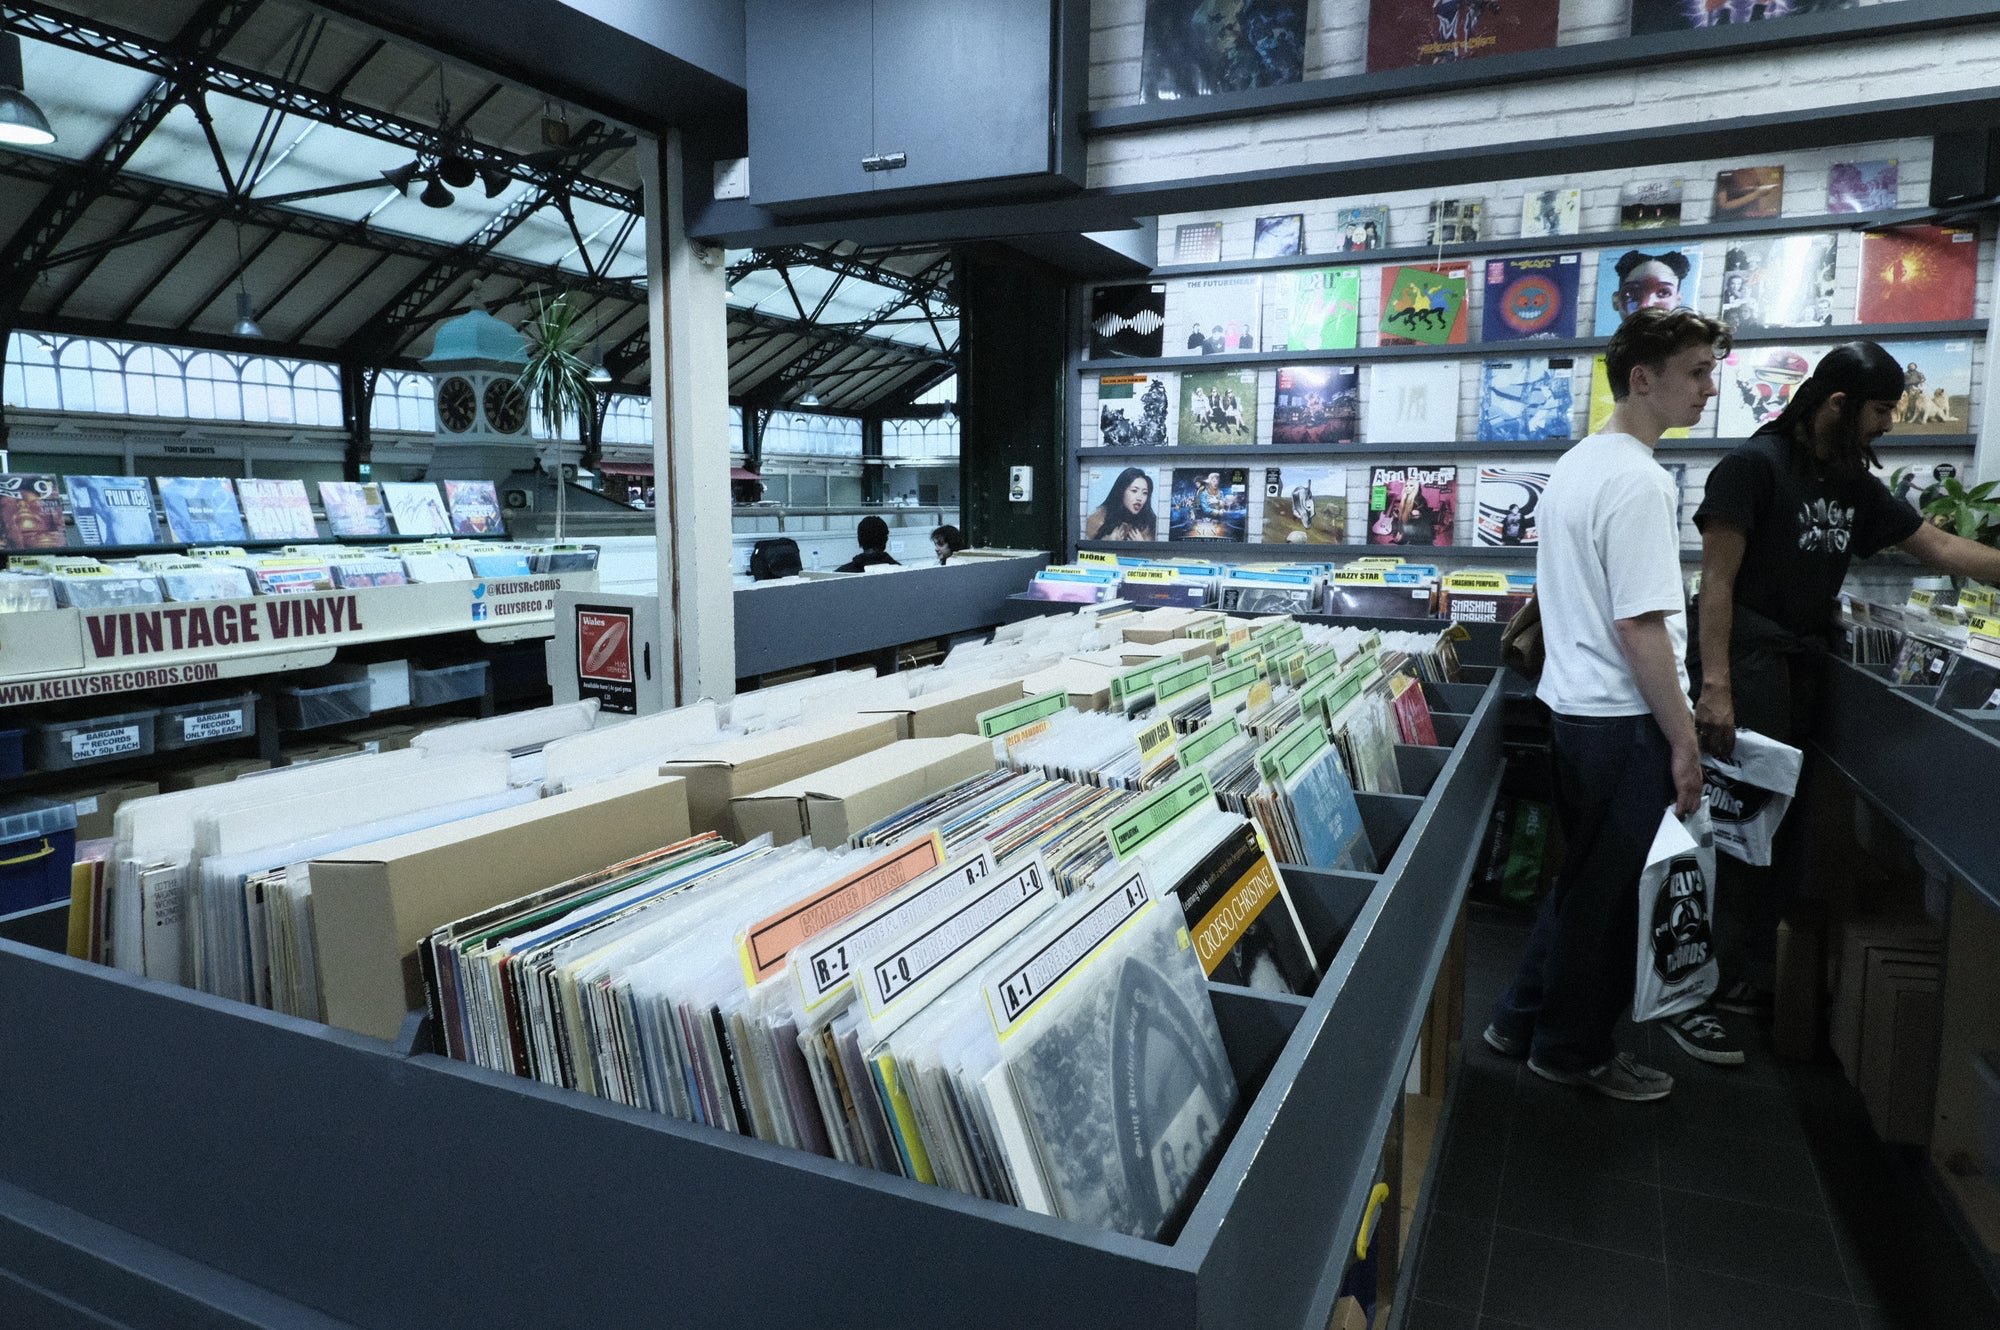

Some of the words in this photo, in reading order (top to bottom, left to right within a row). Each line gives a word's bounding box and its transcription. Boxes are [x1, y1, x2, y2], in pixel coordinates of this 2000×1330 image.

[1187, 281, 1202, 289] THE
[106, 489, 130, 507] THIN
[131, 490, 148, 507] ICE
[1079, 552, 1106, 562] BJÖRK
[66, 566, 102, 575] SUEDE
[1127, 570, 1147, 579] COCTEAU
[1148, 571, 1163, 579] TWINS
[1334, 572, 1358, 581] MAZZY
[1359, 572, 1379, 580] STAR
[1451, 579, 1474, 588] SMASHING
[1474, 580, 1500, 588] PUMPKINS
[1450, 599, 1497, 613] SMASHING
[86, 603, 260, 658] VINTAGE
[266, 595, 363, 639] VINYL
[583, 616, 606, 627] Wales
[1970, 617, 1986, 630] NAS
[197, 712, 230, 724] BARGAIN
[201, 718, 236, 730] RECORDS
[86, 729, 125, 741] BARGAIN
[185, 730, 207, 740] ONLY
[221, 724, 242, 735] EACH
[1138, 728, 1159, 754] JOHNNY
[1156, 721, 1171, 742] CASH
[91, 735, 132, 749] RECORDS
[73, 748, 98, 759] ONLY
[115, 741, 139, 753] EACH
[800, 887, 860, 937] CYMRAEG
[866, 862, 907, 897] WELSH
[1181, 891, 1201, 912] Learning
[1196, 880, 1210, 898] Welsh
[1198, 907, 1239, 960] CROESO,
[1231, 866, 1274, 921] CHRISTINE!
[911, 932, 944, 972] RARE
[1030, 952, 1062, 990] RARE
